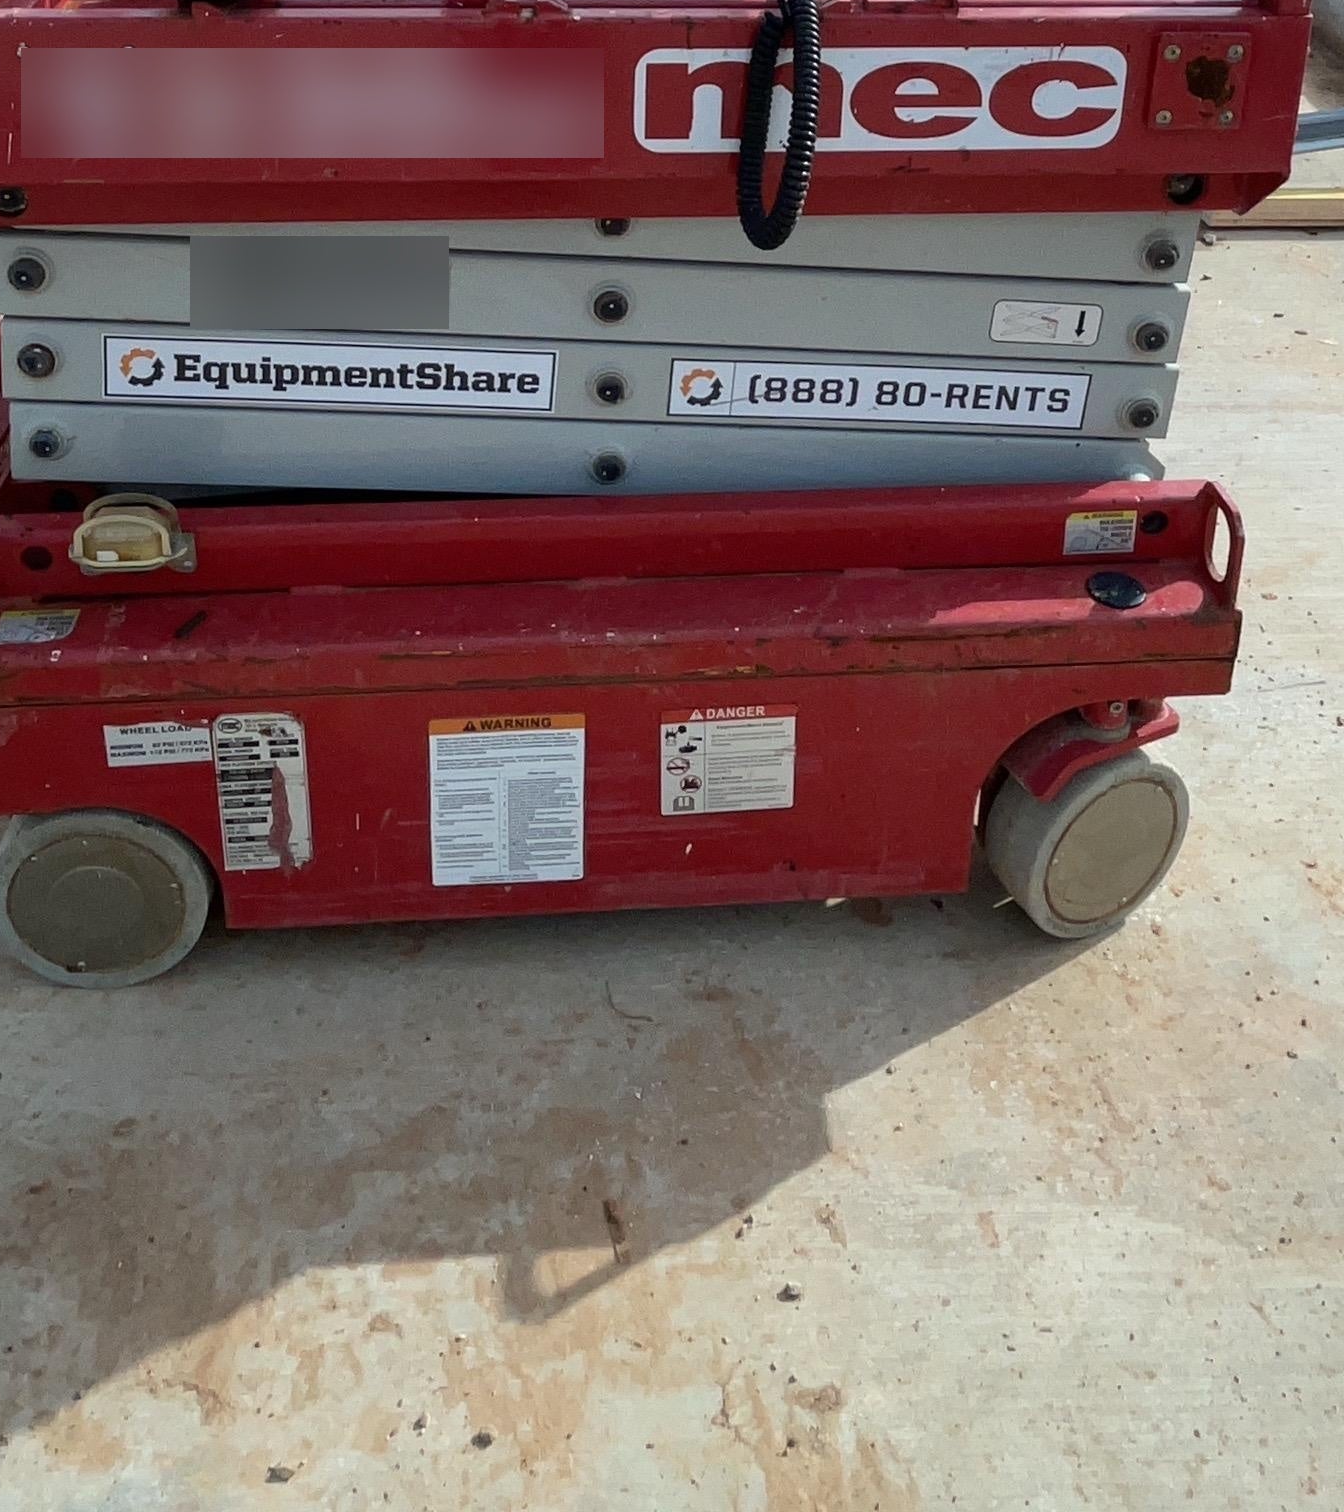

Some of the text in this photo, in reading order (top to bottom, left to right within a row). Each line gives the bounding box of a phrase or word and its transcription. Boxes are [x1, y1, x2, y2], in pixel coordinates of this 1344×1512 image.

[644, 60, 1118, 140] mec
[173, 353, 541, 395] EquipmentShare
[748, 374, 1071, 414] (888) 80-RENTS
[480, 717, 552, 730] WARNING
[706, 705, 766, 720] DANGER
[120, 724, 193, 735] WHEEL LOAD
